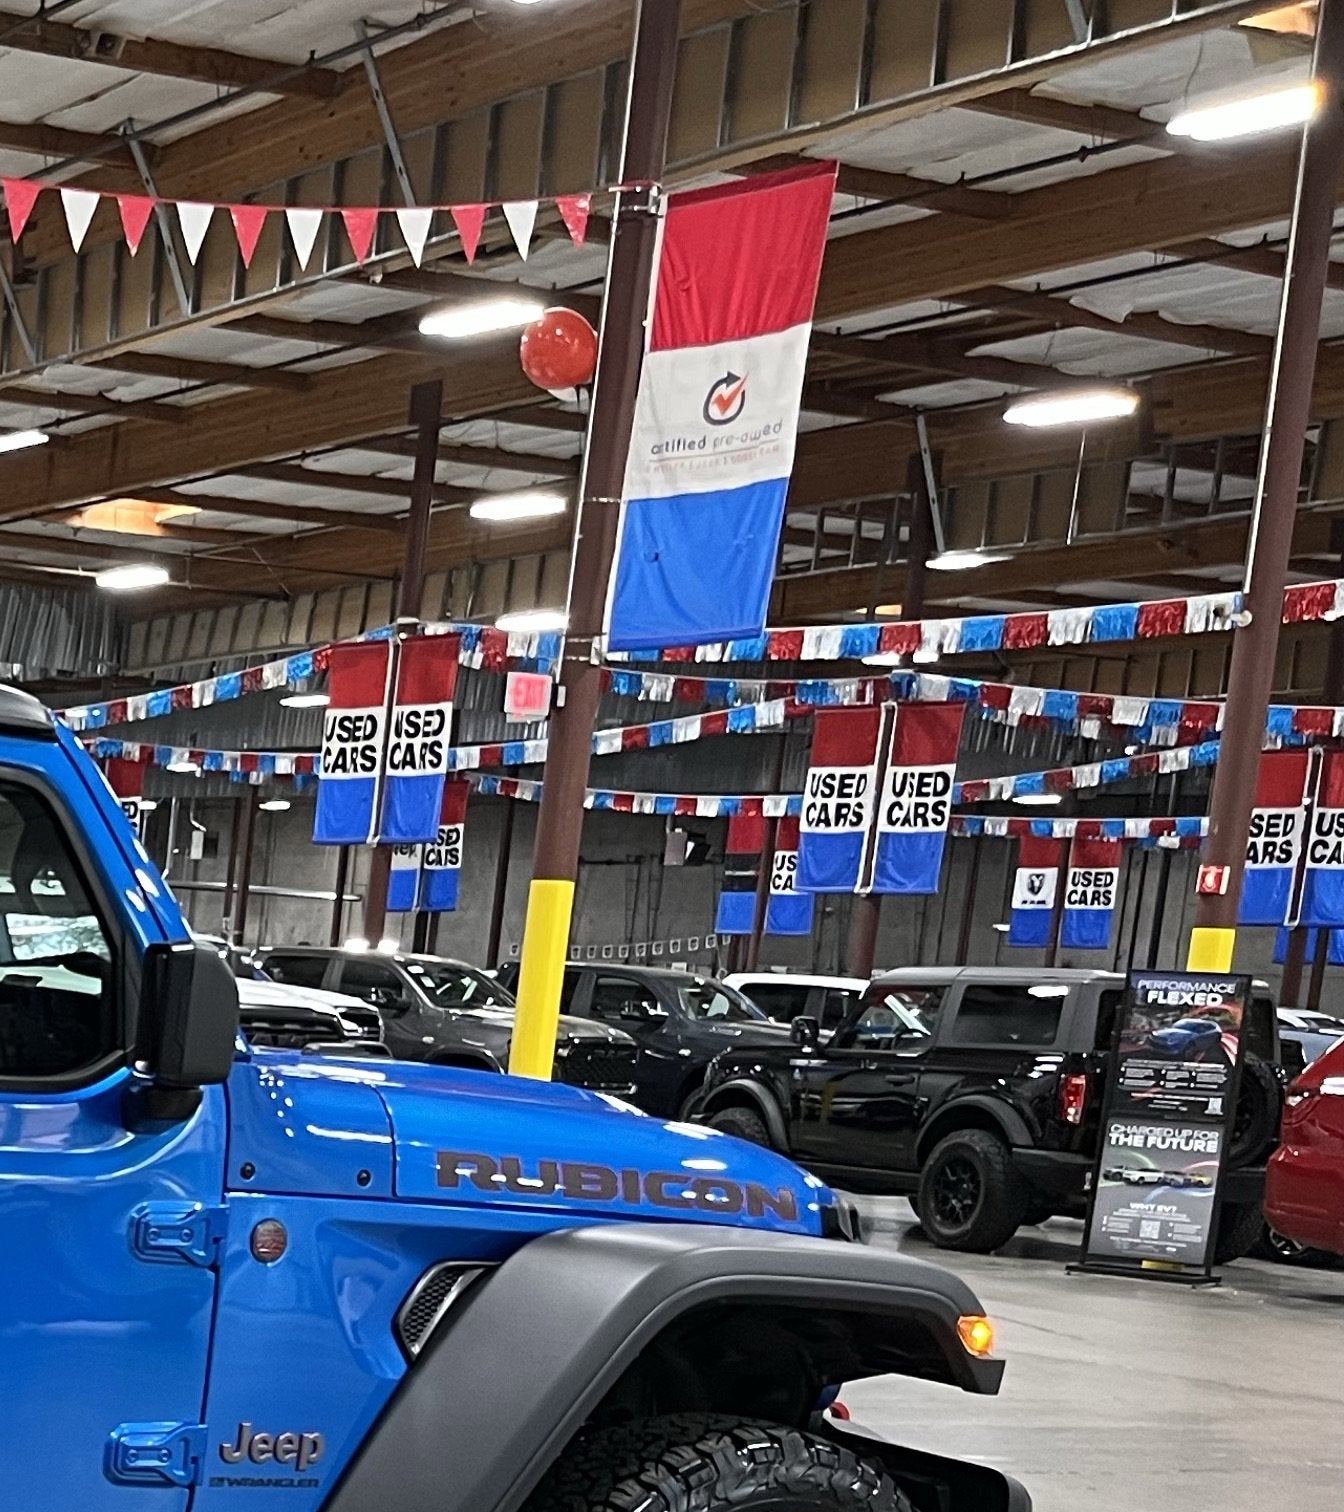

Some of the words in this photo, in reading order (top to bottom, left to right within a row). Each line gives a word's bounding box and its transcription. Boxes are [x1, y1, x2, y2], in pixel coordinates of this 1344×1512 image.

[324, 714, 378, 742] USED
[394, 708, 446, 739] USED
[322, 745, 377, 774] CARS
[389, 740, 443, 770] CARS
[810, 773, 868, 799] USED
[891, 771, 951, 799] USED
[122, 801, 138, 819] ED
[805, 802, 864, 828] CARS
[886, 800, 948, 827] CARS
[1248, 814, 1295, 838] SED
[775, 854, 797, 872] US
[1246, 840, 1293, 865] ARS
[1310, 840, 1344, 865] CA
[772, 874, 793, 891] CA
[1071, 871, 1114, 888] USED
[1067, 890, 1112, 906] CARS
[1137, 979, 1236, 994] PERFORMANCE
[1147, 990, 1224, 1006] FLEXED
[1109, 1133, 1143, 1147] THE
[1147, 1135, 1218, 1153] FUTURE
[1111, 1124, 1173, 1138] CHARGED
[1175, 1128, 1192, 1139] UP
[1193, 1130, 1219, 1140] FOR
[436, 1151, 798, 1221] RUBICON
[219, 1422, 324, 1472] Jeep
[227, 1477, 319, 1487] WRANGLER
